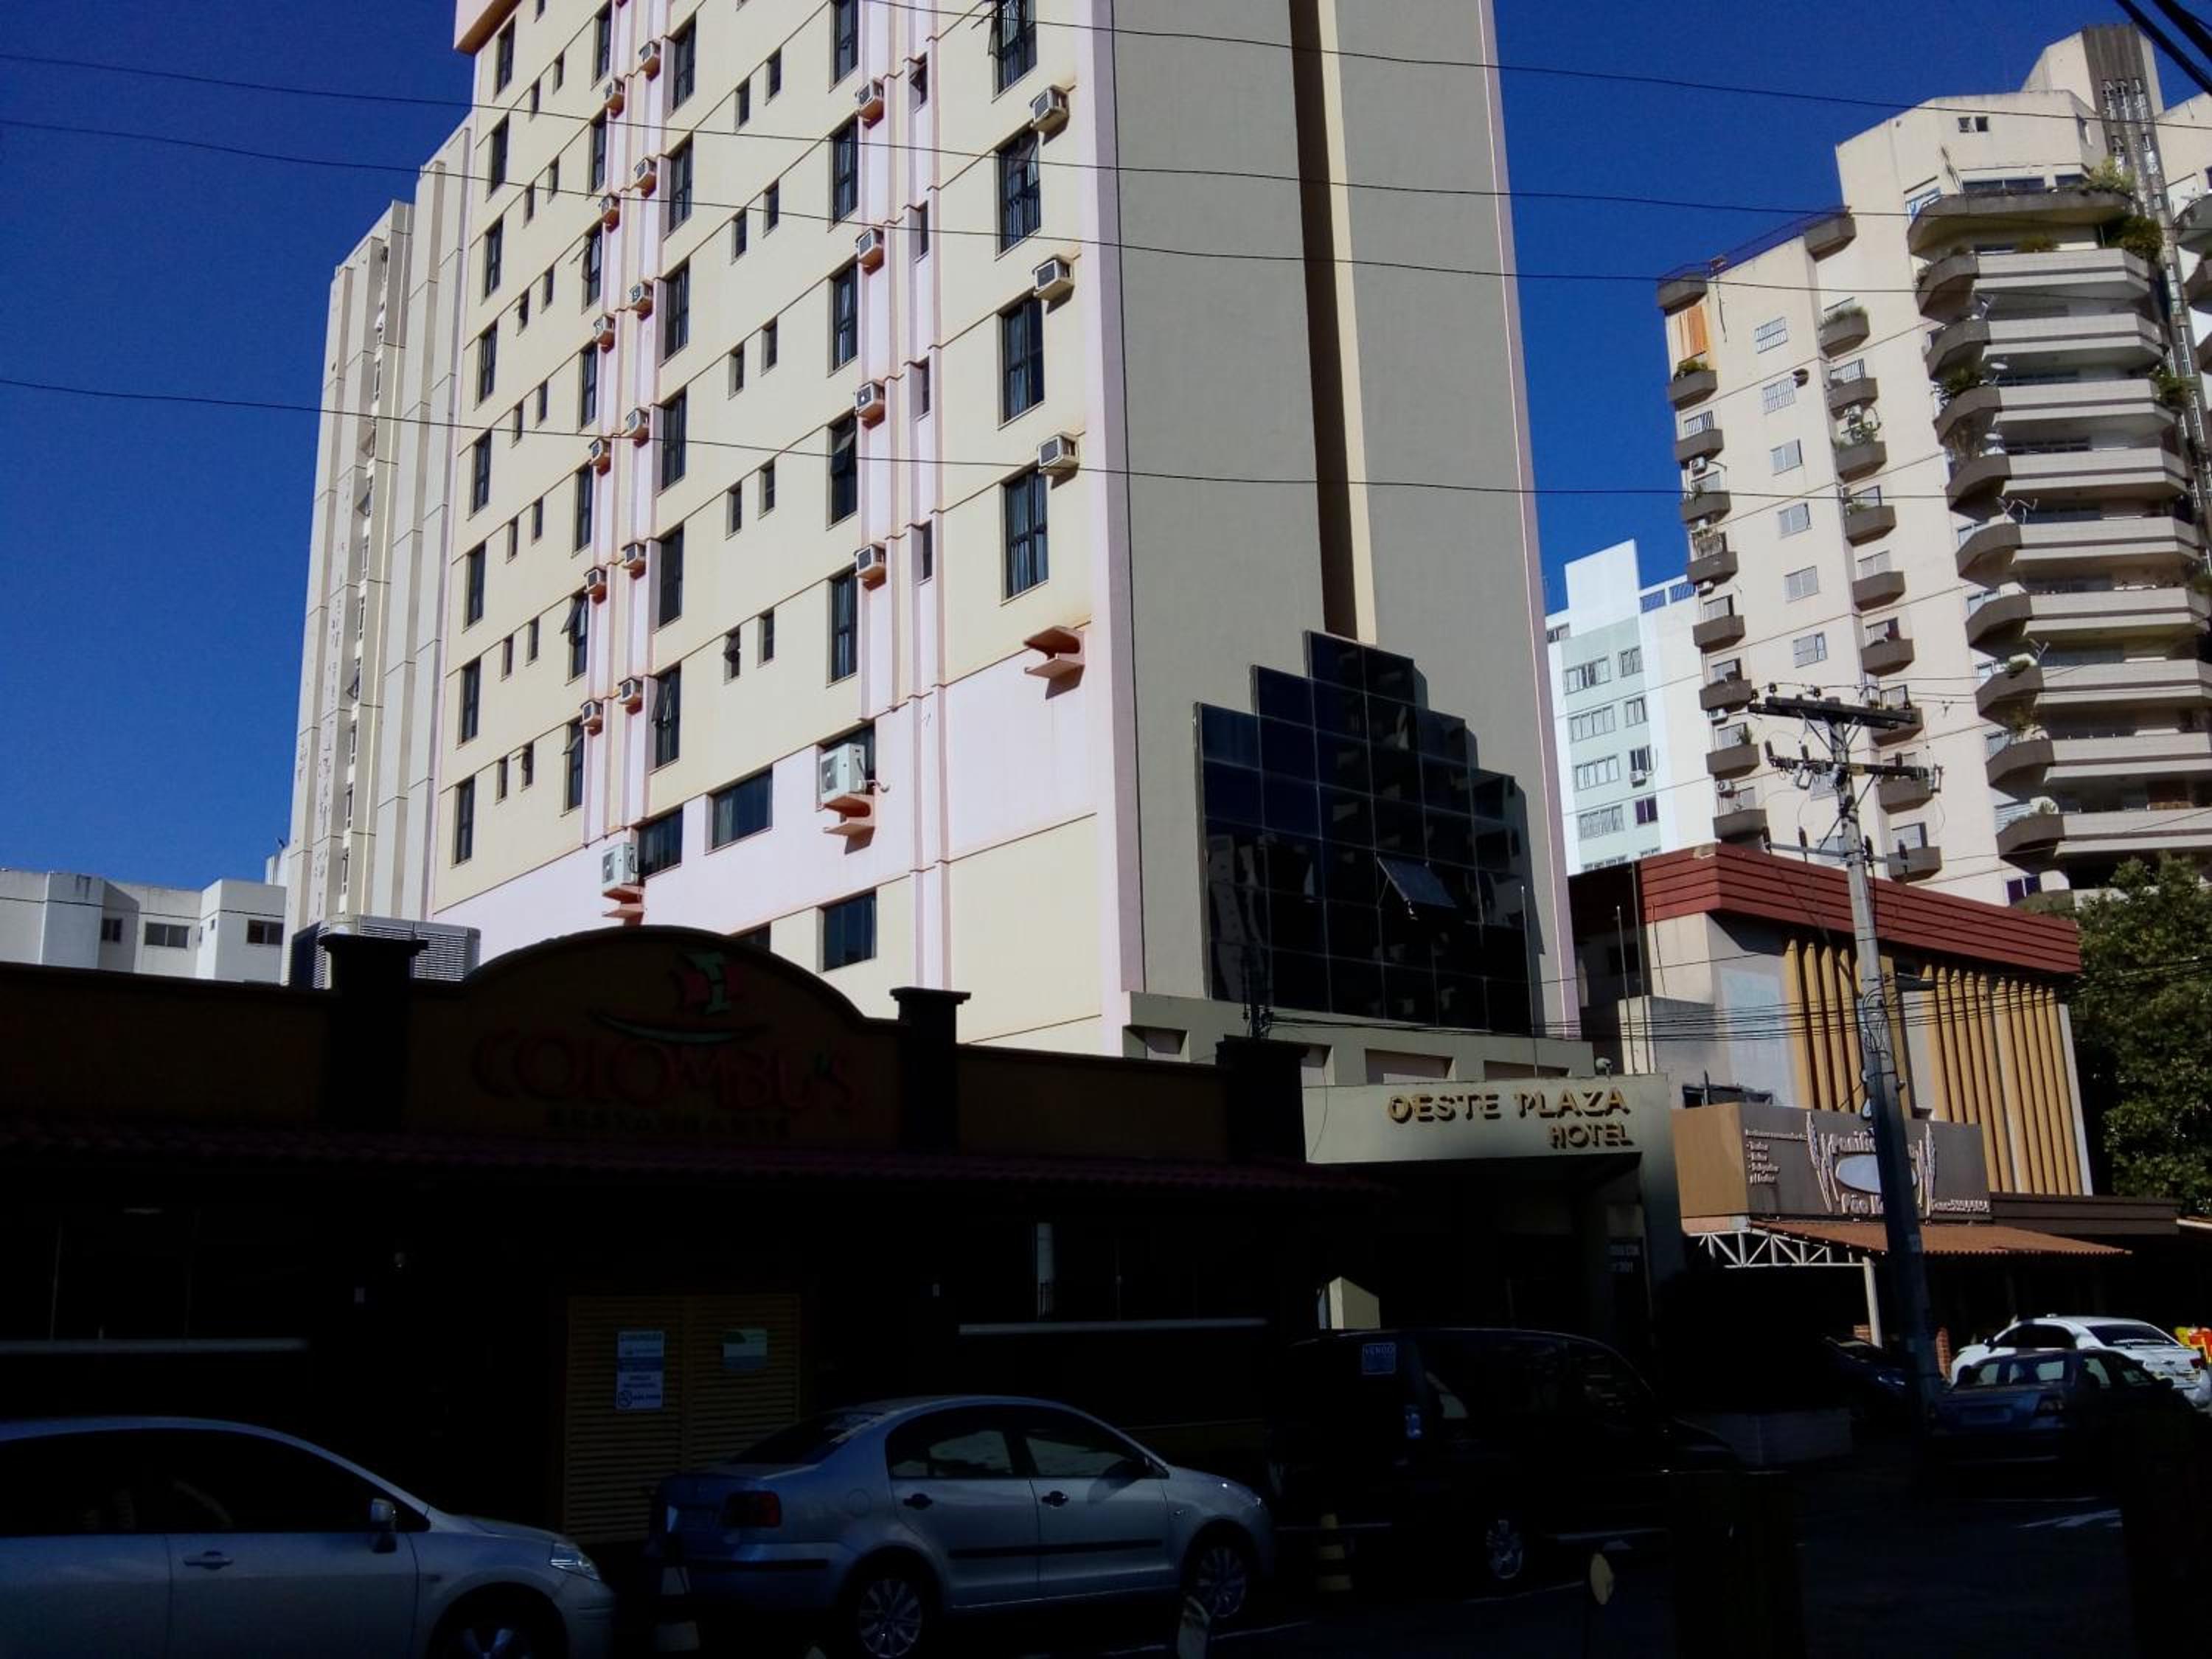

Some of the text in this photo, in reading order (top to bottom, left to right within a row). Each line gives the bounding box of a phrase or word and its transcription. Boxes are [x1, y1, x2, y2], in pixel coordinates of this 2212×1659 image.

[1388, 1085, 1631, 1124] OESTE PLAZA
[1549, 1122, 1634, 1149] HOTEL
